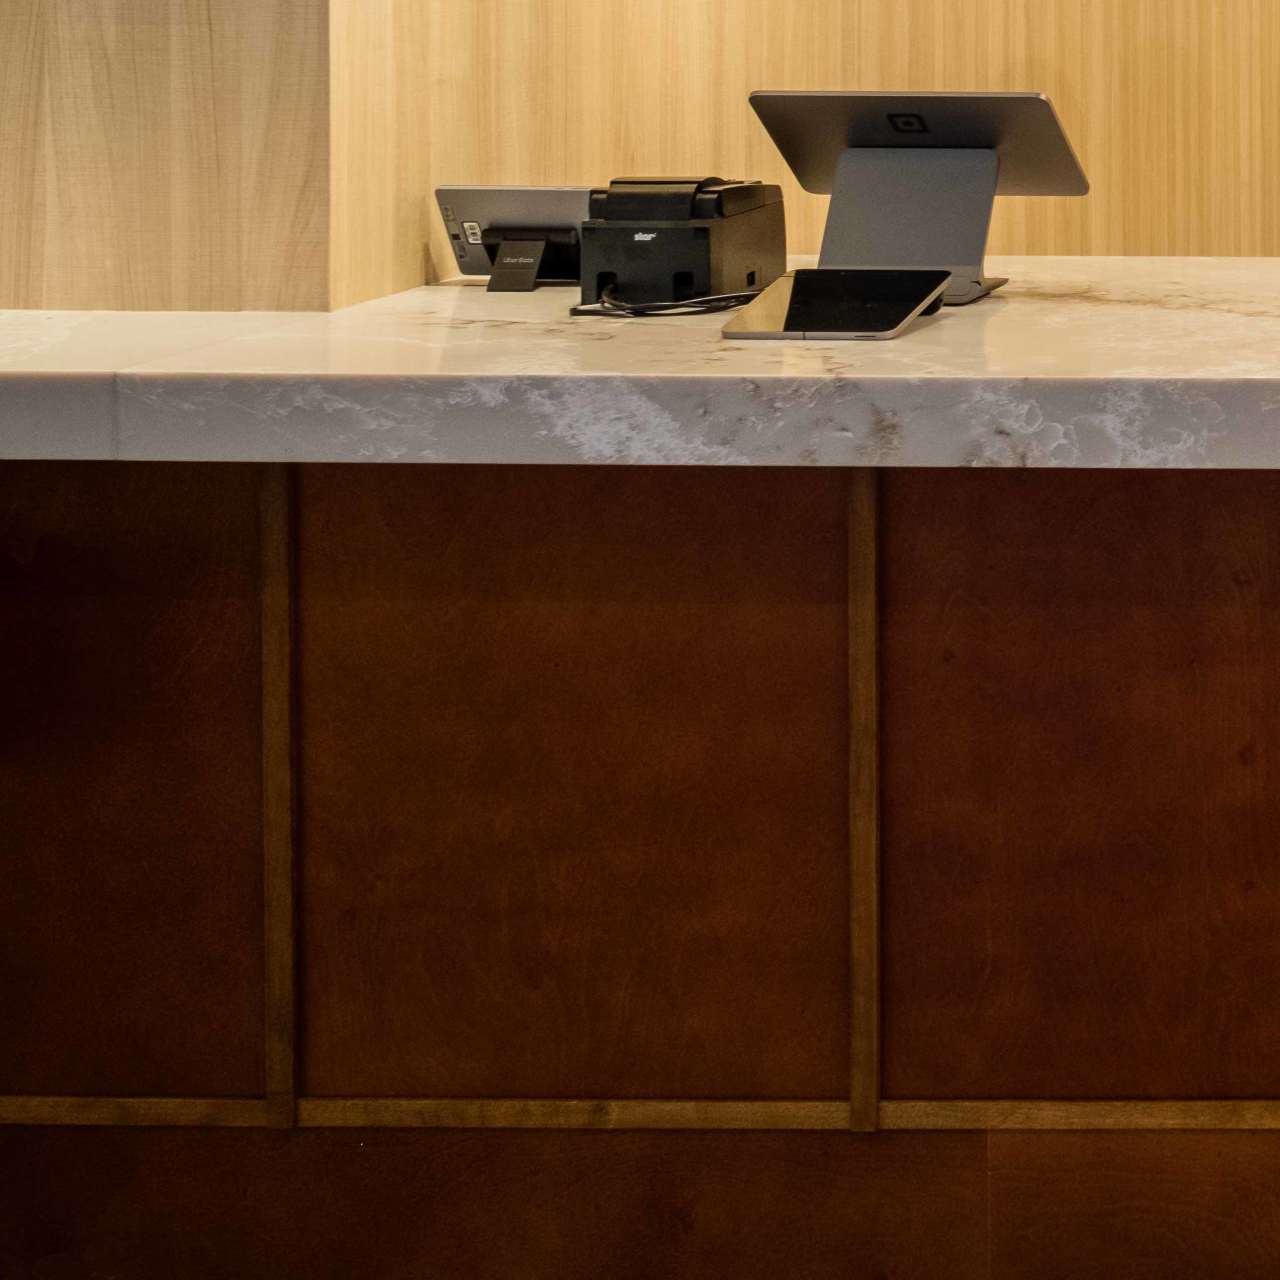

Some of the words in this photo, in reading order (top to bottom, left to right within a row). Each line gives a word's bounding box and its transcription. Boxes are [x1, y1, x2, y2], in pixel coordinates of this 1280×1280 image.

[633, 232, 656, 241] star
[503, 255, 518, 264] Uber
[519, 255, 534, 264] Eats
